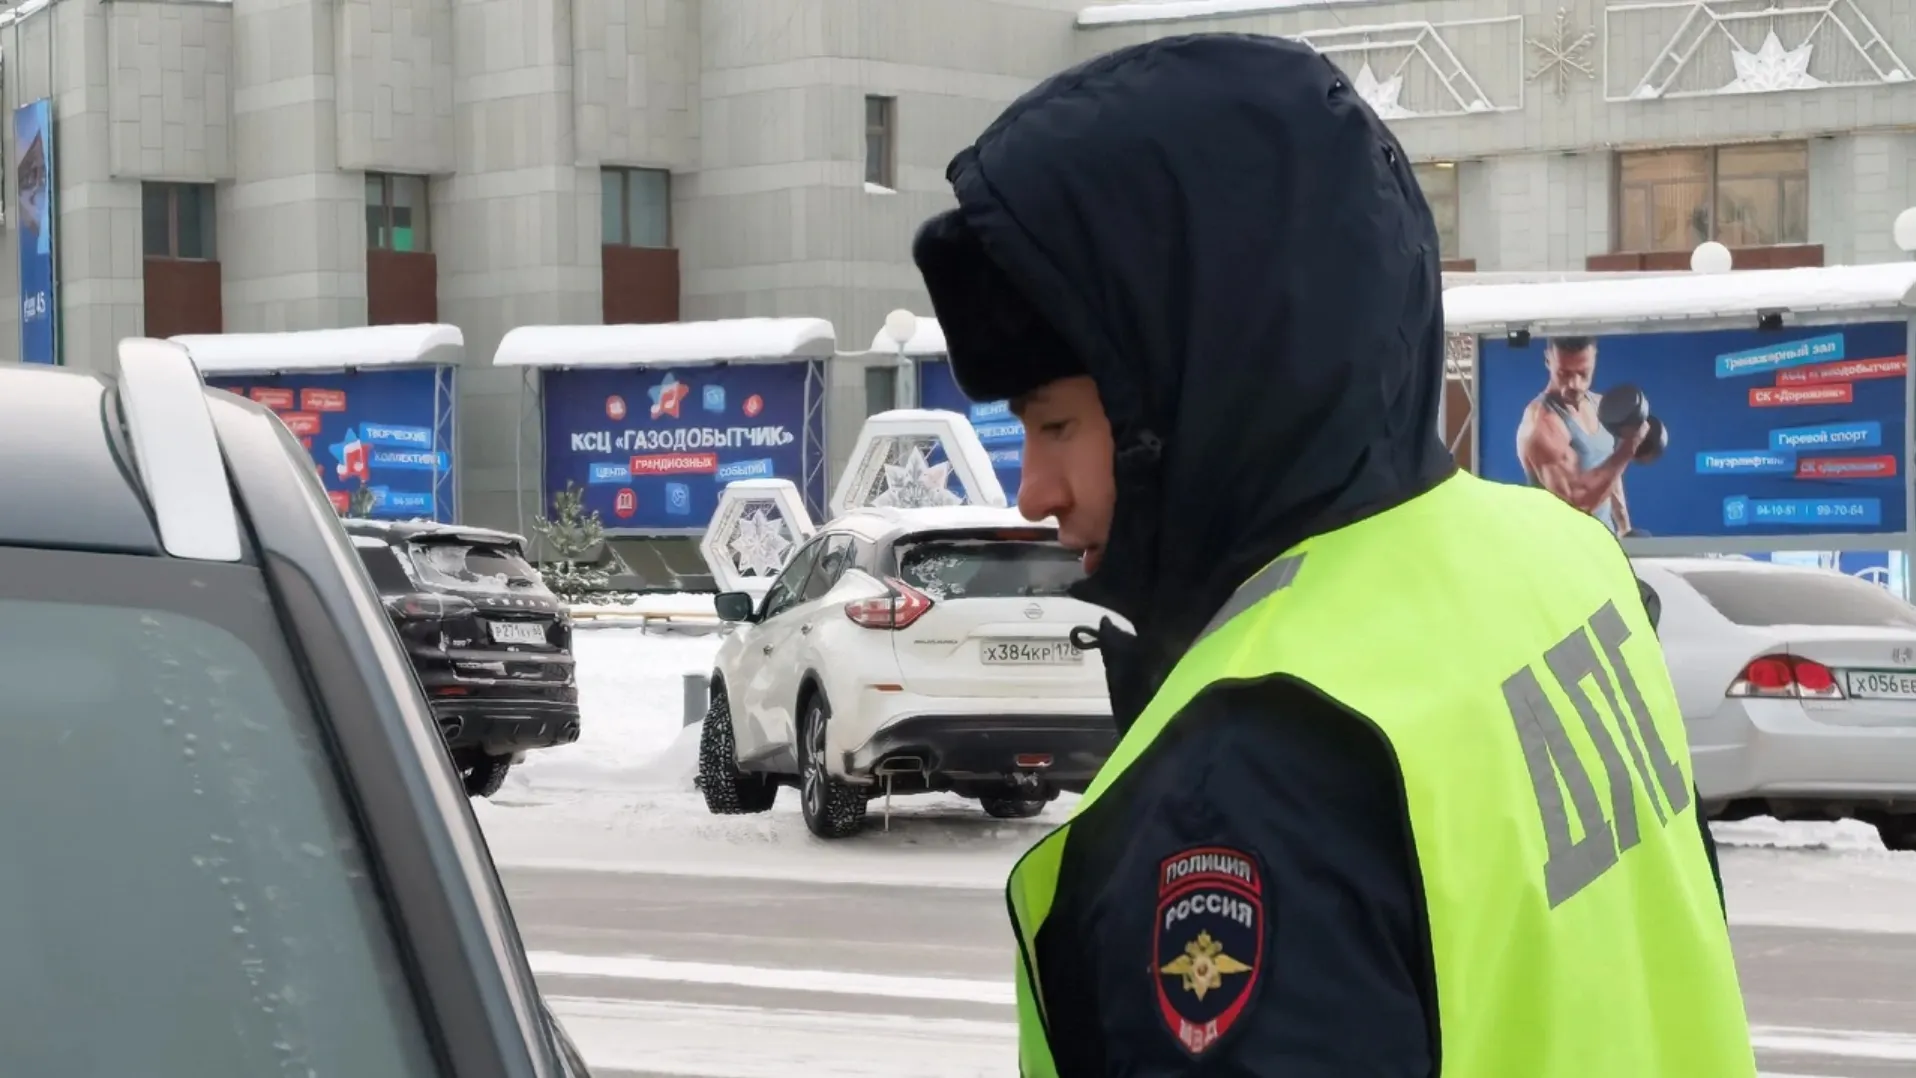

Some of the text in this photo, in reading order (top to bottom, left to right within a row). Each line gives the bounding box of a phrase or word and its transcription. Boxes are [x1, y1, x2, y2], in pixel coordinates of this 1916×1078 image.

[1812, 341, 1836, 355] зал
[571, 425, 794, 453] КСЦ «ГАЗОДОБЫТЧИК»
[1830, 430, 1868, 444] спорт
[596, 456, 768, 479] ЦЕНТР ГРАНДИОЗНЫХ СОБЫТИЙ
[1500, 598, 1691, 911] ДПС
[1166, 854, 1250, 884] ПОЛИЦИЯ
[1165, 894, 1253, 930] РОССИЯ
